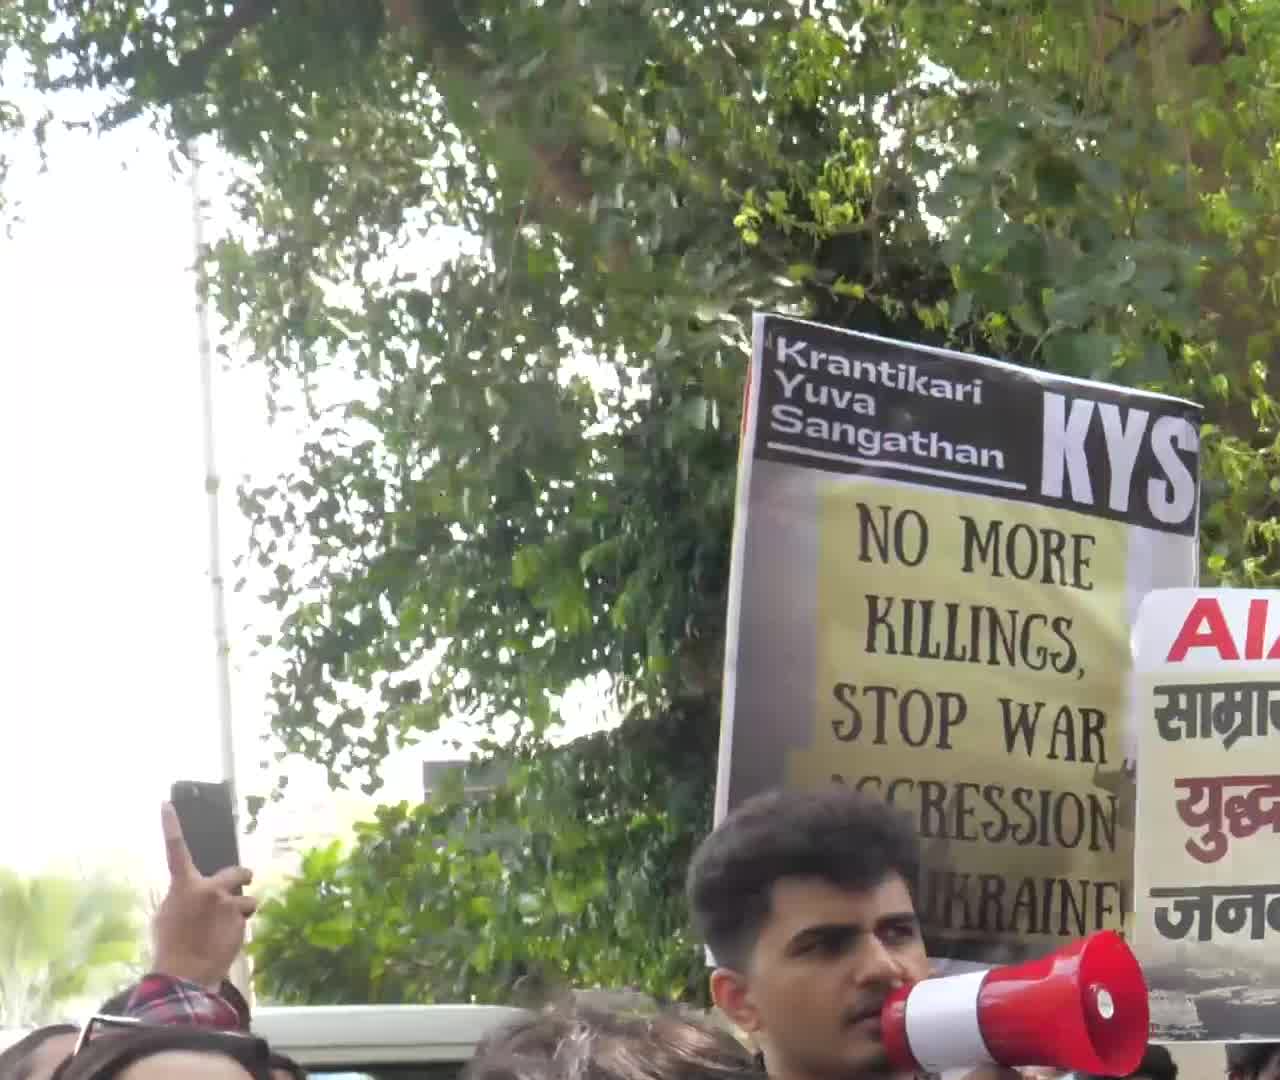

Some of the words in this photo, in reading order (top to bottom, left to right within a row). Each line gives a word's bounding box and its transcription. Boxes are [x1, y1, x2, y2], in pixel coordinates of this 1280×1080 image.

[774, 370, 876, 416] Yuva
[776, 336, 983, 403] Krantikari
[770, 405, 1005, 469] Sangathan
[1040, 391, 1198, 524] KYS
[856, 502, 929, 567] NO
[959, 516, 1096, 591] MORE
[863, 595, 1085, 680] KILLINGS,
[832, 682, 967, 749] STOP
[1000, 698, 1108, 764] WAR
[831, 774, 1118, 852] RESSION
